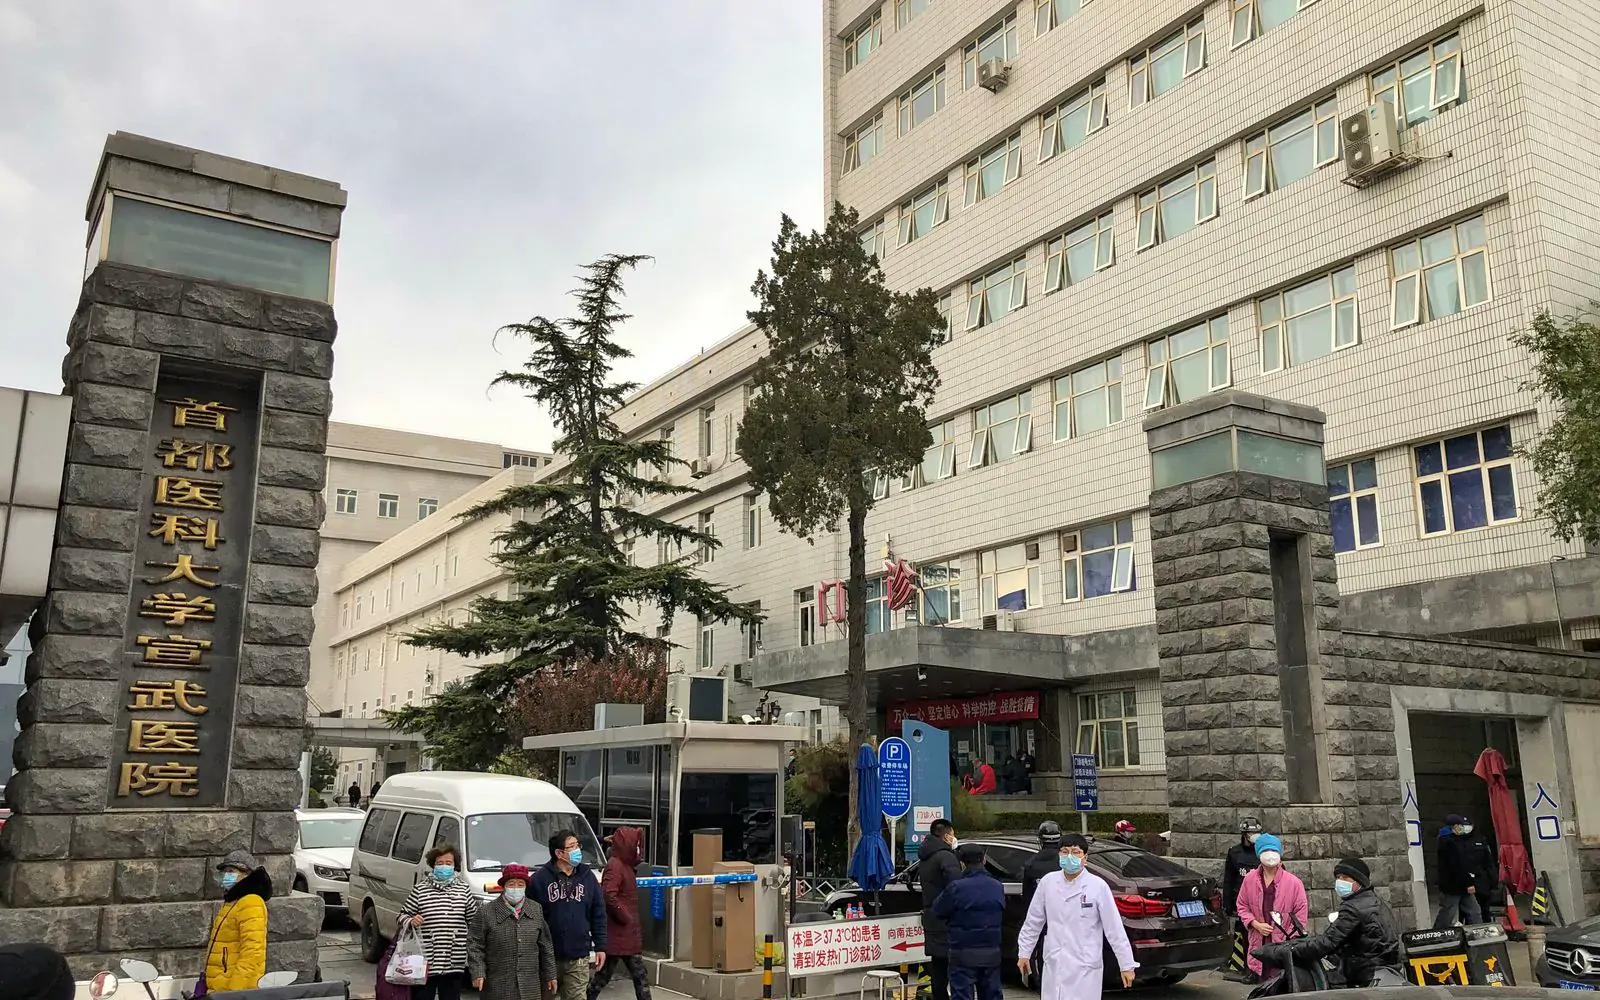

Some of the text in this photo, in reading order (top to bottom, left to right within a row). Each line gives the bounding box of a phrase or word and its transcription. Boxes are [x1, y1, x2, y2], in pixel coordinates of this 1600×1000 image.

[118, 397, 241, 797] 首都医科大学宣武医院
[893, 696, 1035, 723] 万众一心 坚定信心 科学防控 战胜疫情
[916, 811, 942, 820] 门诊入口
[1531, 782, 1561, 841] 入口
[792, 943, 882, 970] 请到发热门诊就诊
